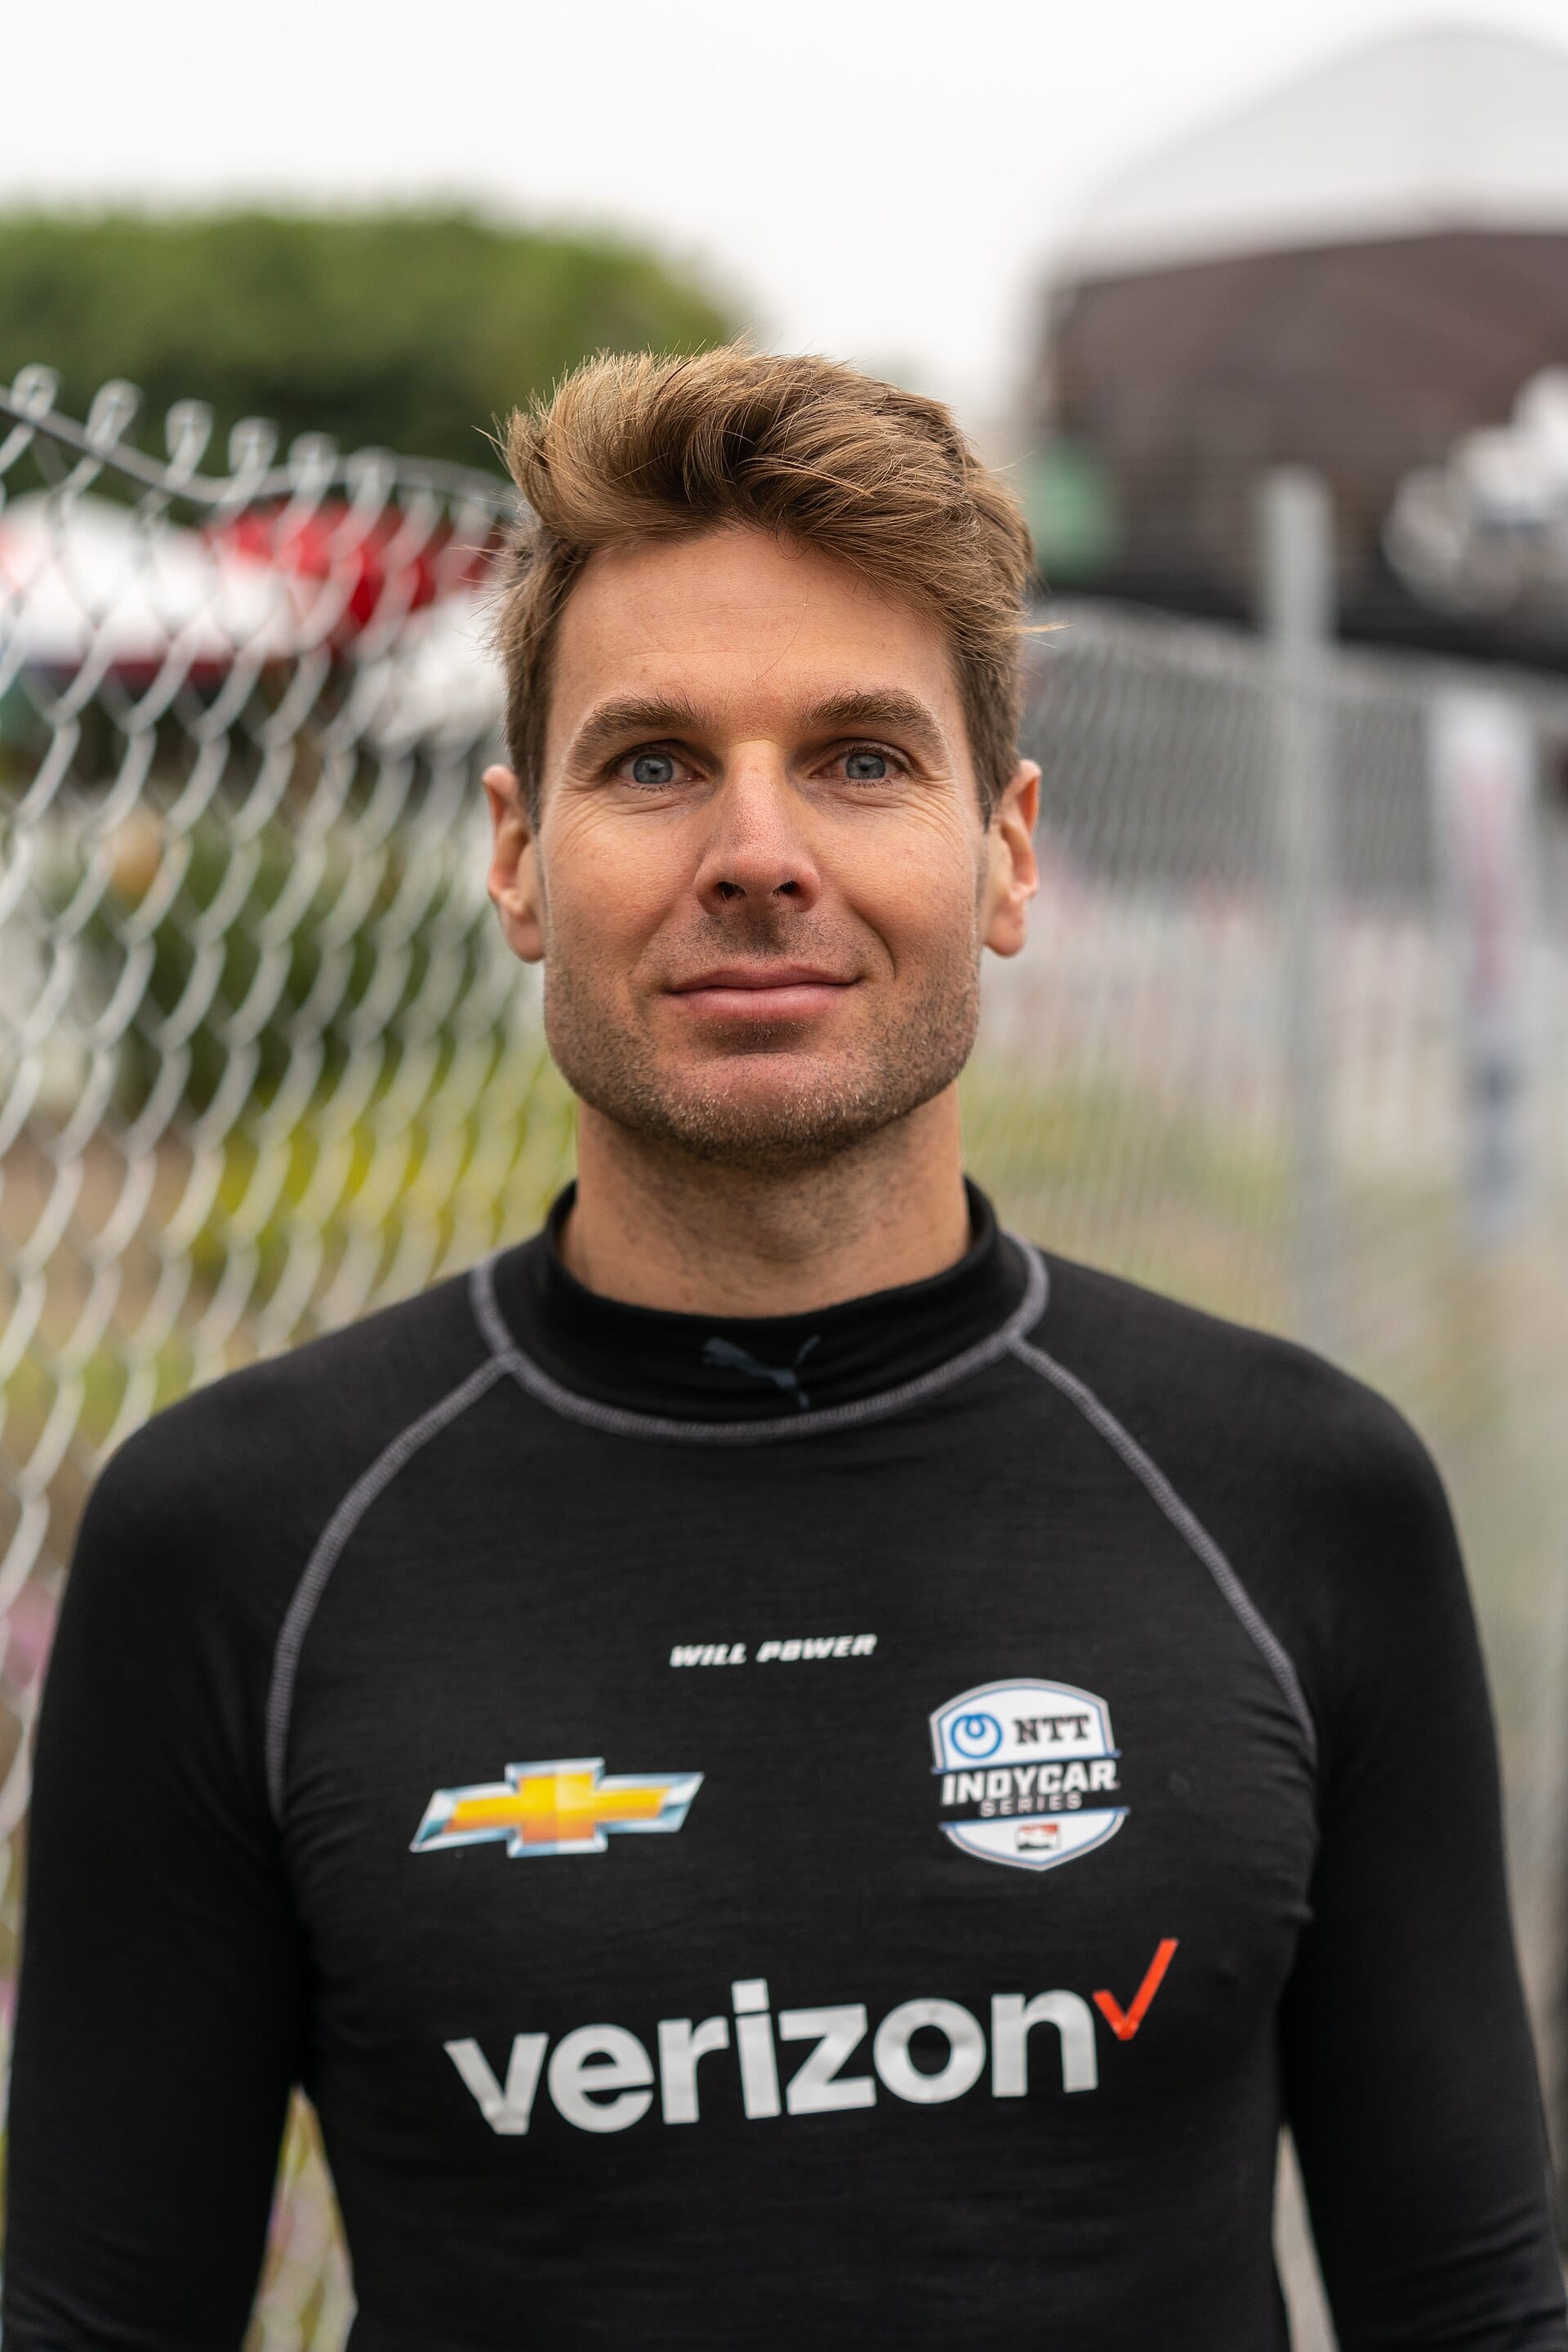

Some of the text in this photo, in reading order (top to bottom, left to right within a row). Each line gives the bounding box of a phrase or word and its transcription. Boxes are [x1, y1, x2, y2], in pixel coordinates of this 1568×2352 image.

[670, 1633, 878, 1667] WILL POWER
[1014, 1714, 1089, 1744] NTT
[942, 1759, 1118, 1806] INDYCAR
[979, 1791, 1082, 1817] SERIES
[443, 1978, 1098, 2136] verizon
